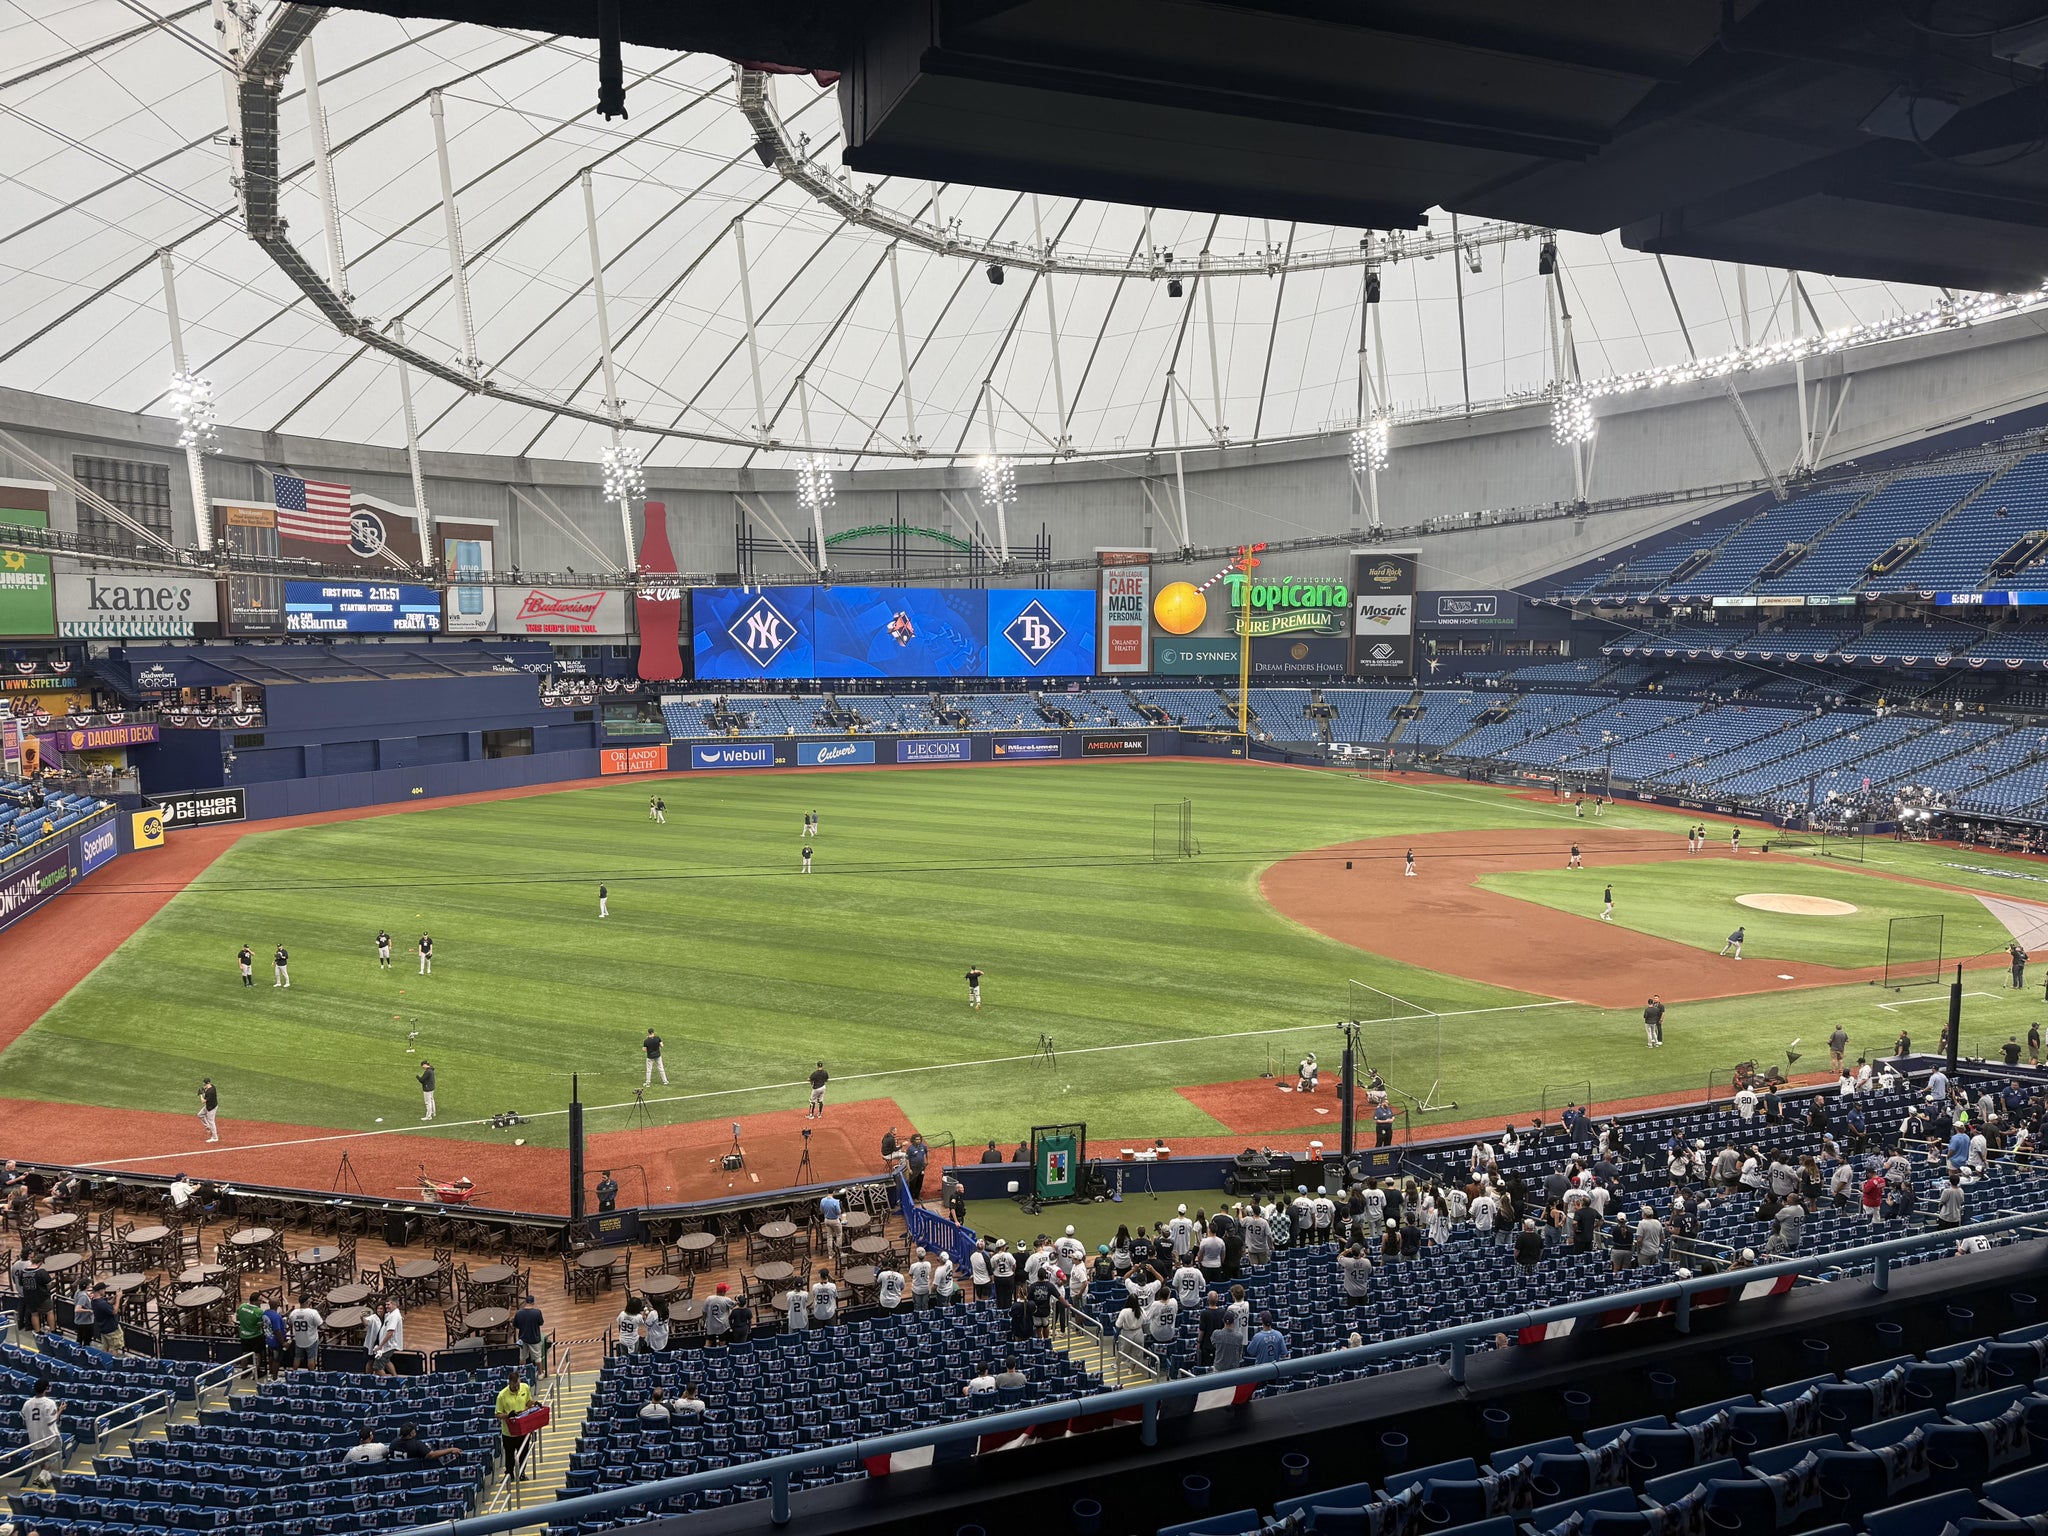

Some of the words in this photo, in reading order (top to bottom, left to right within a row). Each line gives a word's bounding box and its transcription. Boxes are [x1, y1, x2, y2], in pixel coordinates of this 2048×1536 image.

[1109, 578, 1142, 595] CARE
[86, 577, 191, 611] kane's
[322, 588, 341, 597] FIRST
[369, 588, 400, 600] 2:11:51
[1224, 574, 1348, 611] Tropicana
[1109, 596, 1142, 612] MADE
[1952, 594, 1970, 604] 5:58
[1970, 594, 1982, 604] PM
[524, 598, 597, 613] Budweiser
[1360, 604, 1406, 616] Mosaic
[1108, 612, 1142, 621] PERSONAL
[300, 619, 348, 630] SCHLITTLER
[394, 620, 426, 629] PERALTA
[526, 624, 542, 632] THIS
[566, 624, 580, 632] FOR
[1236, 619, 1270, 632] PURE
[1272, 614, 1331, 630] PREMIUM
[1180, 652, 1193, 660] TD
[1196, 652, 1238, 660] SYNNEX
[1255, 663, 1282, 671] DREAM
[1284, 663, 1314, 671] FINDERS
[1316, 663, 1344, 671] HOMES
[6, 678, 78, 690] WWW.STPETE.ORG
[138, 678, 176, 688] PORCH
[88, 729, 128, 746] DAIQUIRI
[130, 726, 154, 742] DECK
[610, 750, 658, 761] ORLANDO
[722, 750, 766, 762] Webull
[817, 744, 856, 763] Culver's
[176, 796, 236, 808] POWER
[176, 806, 237, 820] DESIGN
[84, 830, 113, 861] Spectrum
[1894, 1162, 1906, 1172] 15
[1772, 1170, 1784, 1180] 99
[1368, 1196, 1379, 1206] 13
[1316, 1204, 1328, 1214] 22
[1481, 1204, 1488, 1214] 2
[1179, 1226, 1185, 1234] 2
[1248, 1224, 1262, 1234] 42
[1975, 1239, 1990, 1250] 27
[1135, 1246, 1148, 1256] 23
[920, 1270, 926, 1278] 2
[1351, 1269, 1364, 1280] 45
[886, 1280, 894, 1291] 2
[1182, 1280, 1196, 1290] 99
[816, 1294, 830, 1304] 99
[712, 1304, 719, 1316] 2
[794, 1302, 801, 1312] 2
[1160, 1314, 1174, 1326] 99
[294, 1320, 309, 1332] 99
[622, 1322, 634, 1332] 99
[32, 1408, 40, 1420] 2
